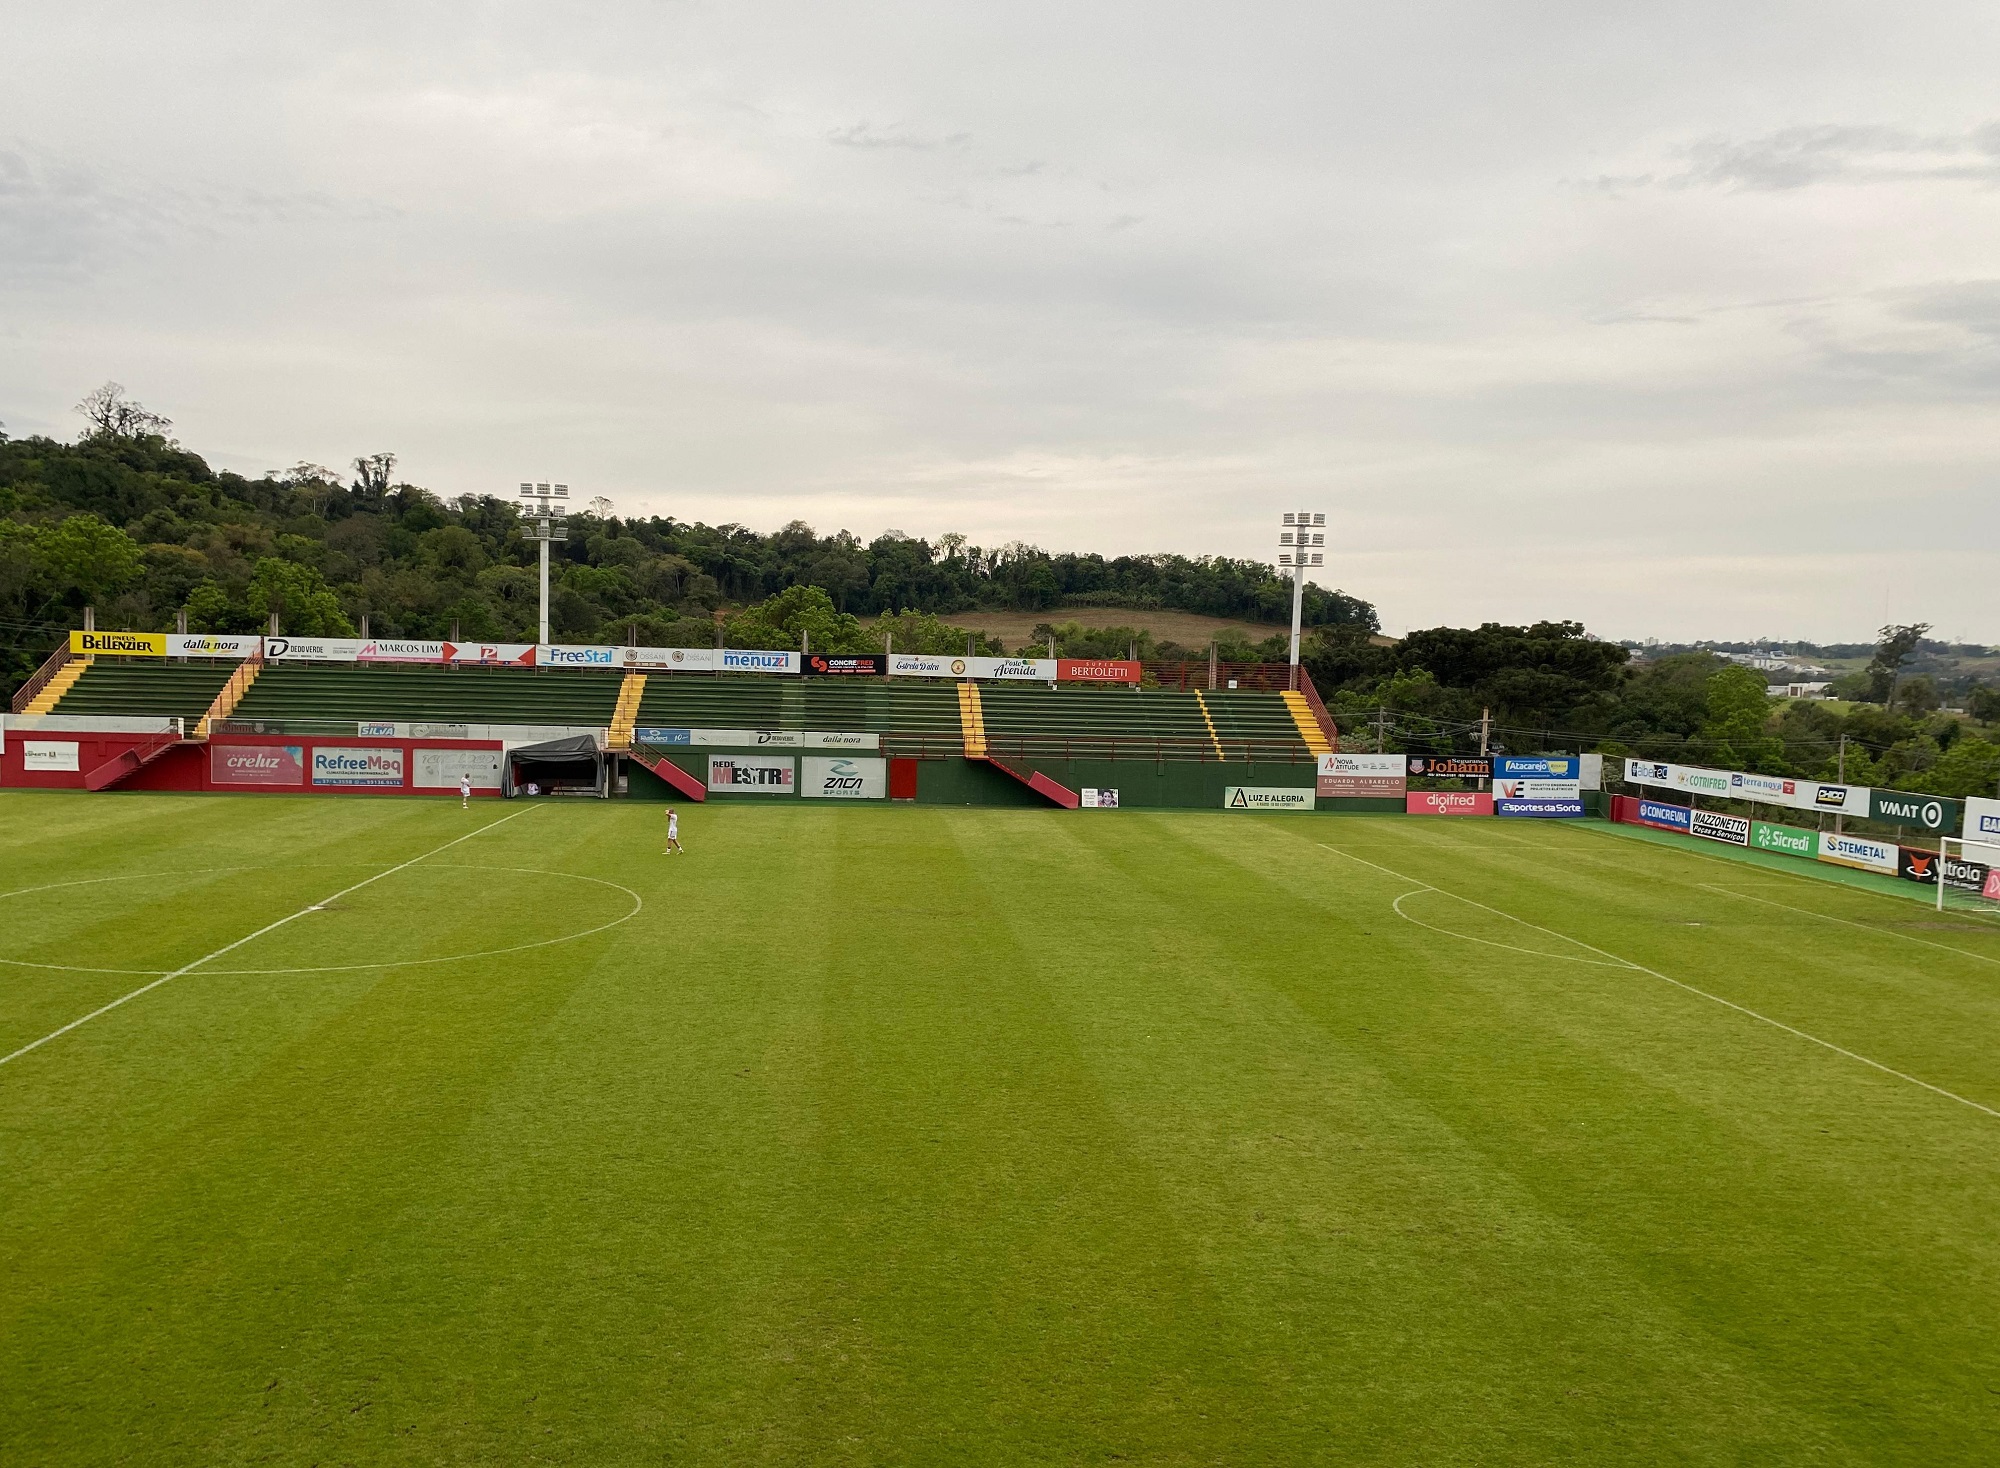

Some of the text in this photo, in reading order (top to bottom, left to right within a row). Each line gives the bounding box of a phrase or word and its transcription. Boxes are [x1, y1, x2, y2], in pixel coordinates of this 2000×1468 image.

[183, 639, 239, 650] dalla nora
[379, 643, 420, 654] MARCOS
[550, 648, 612, 663] FreeStal
[724, 652, 789, 668] menuzzi
[993, 664, 1037, 677] Avenida
[1071, 666, 1128, 677] BERTOLETTI
[361, 727, 395, 735] SILVA
[227, 753, 280, 769] creluz
[315, 754, 400, 775] RefreeMaq
[713, 760, 736, 768] REDE
[1427, 759, 1490, 774] Johann
[1509, 761, 1548, 771] Atacarejo
[712, 768, 793, 785] MESTRE
[1689, 775, 1728, 791] COTRIFRED
[1743, 777, 1782, 790] terra nova
[1248, 794, 1263, 802] LUZ
[1265, 794, 1270, 802] E
[1426, 794, 1476, 814] digifred
[1502, 803, 1581, 812] Esportes da Sorte
[1647, 805, 1688, 824] CONCREVAL
[1879, 800, 1919, 818] VMAT
[1693, 812, 1748, 833] MAZZONETTO
[1693, 824, 1711, 836] Peças
[1716, 829, 1745, 842] Serviços
[1771, 830, 1810, 852] Sicredi
[1838, 841, 1886, 860] STEMETAL
